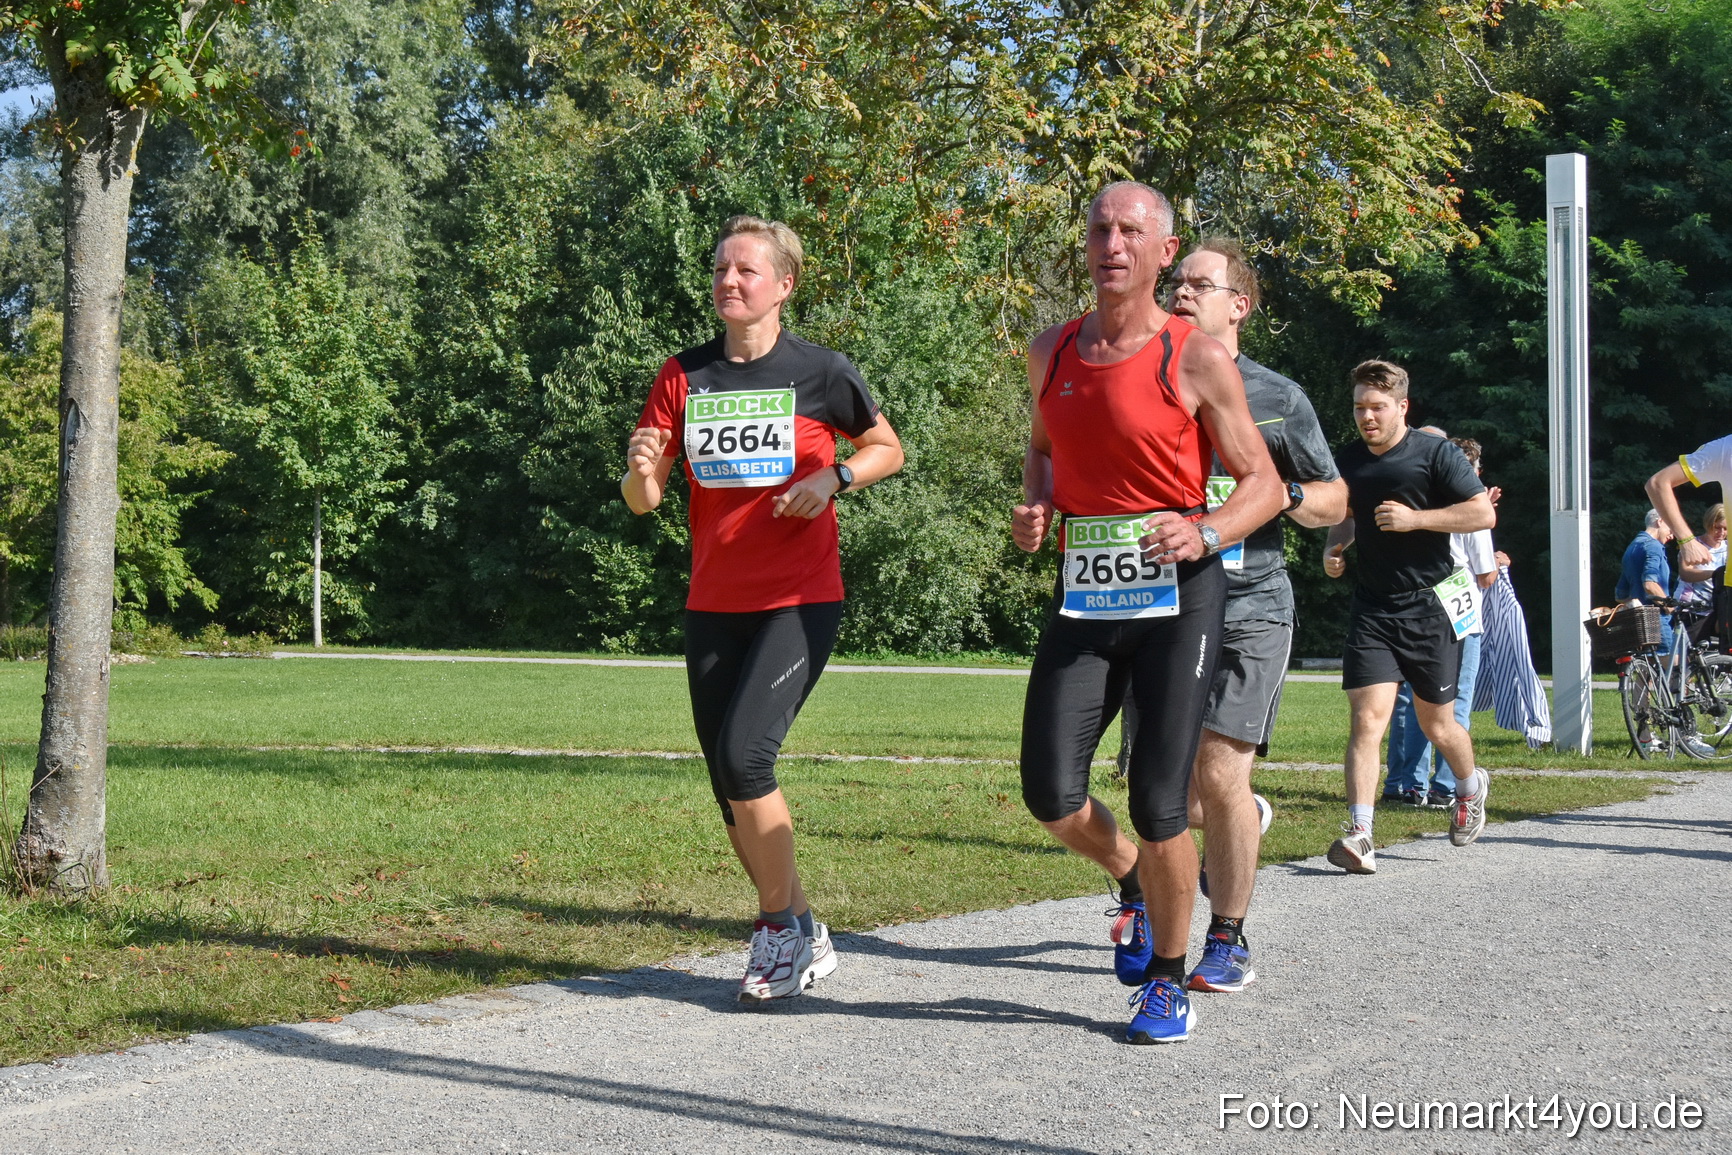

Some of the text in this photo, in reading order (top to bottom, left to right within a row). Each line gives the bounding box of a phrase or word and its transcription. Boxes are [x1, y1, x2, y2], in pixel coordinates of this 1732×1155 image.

[694, 394, 785, 419] BOCK
[698, 423, 781, 456] 2664
[699, 460, 783, 478] ELISABETH
[1075, 552, 1162, 585] 2665
[1085, 591, 1154, 608] ROLAND
